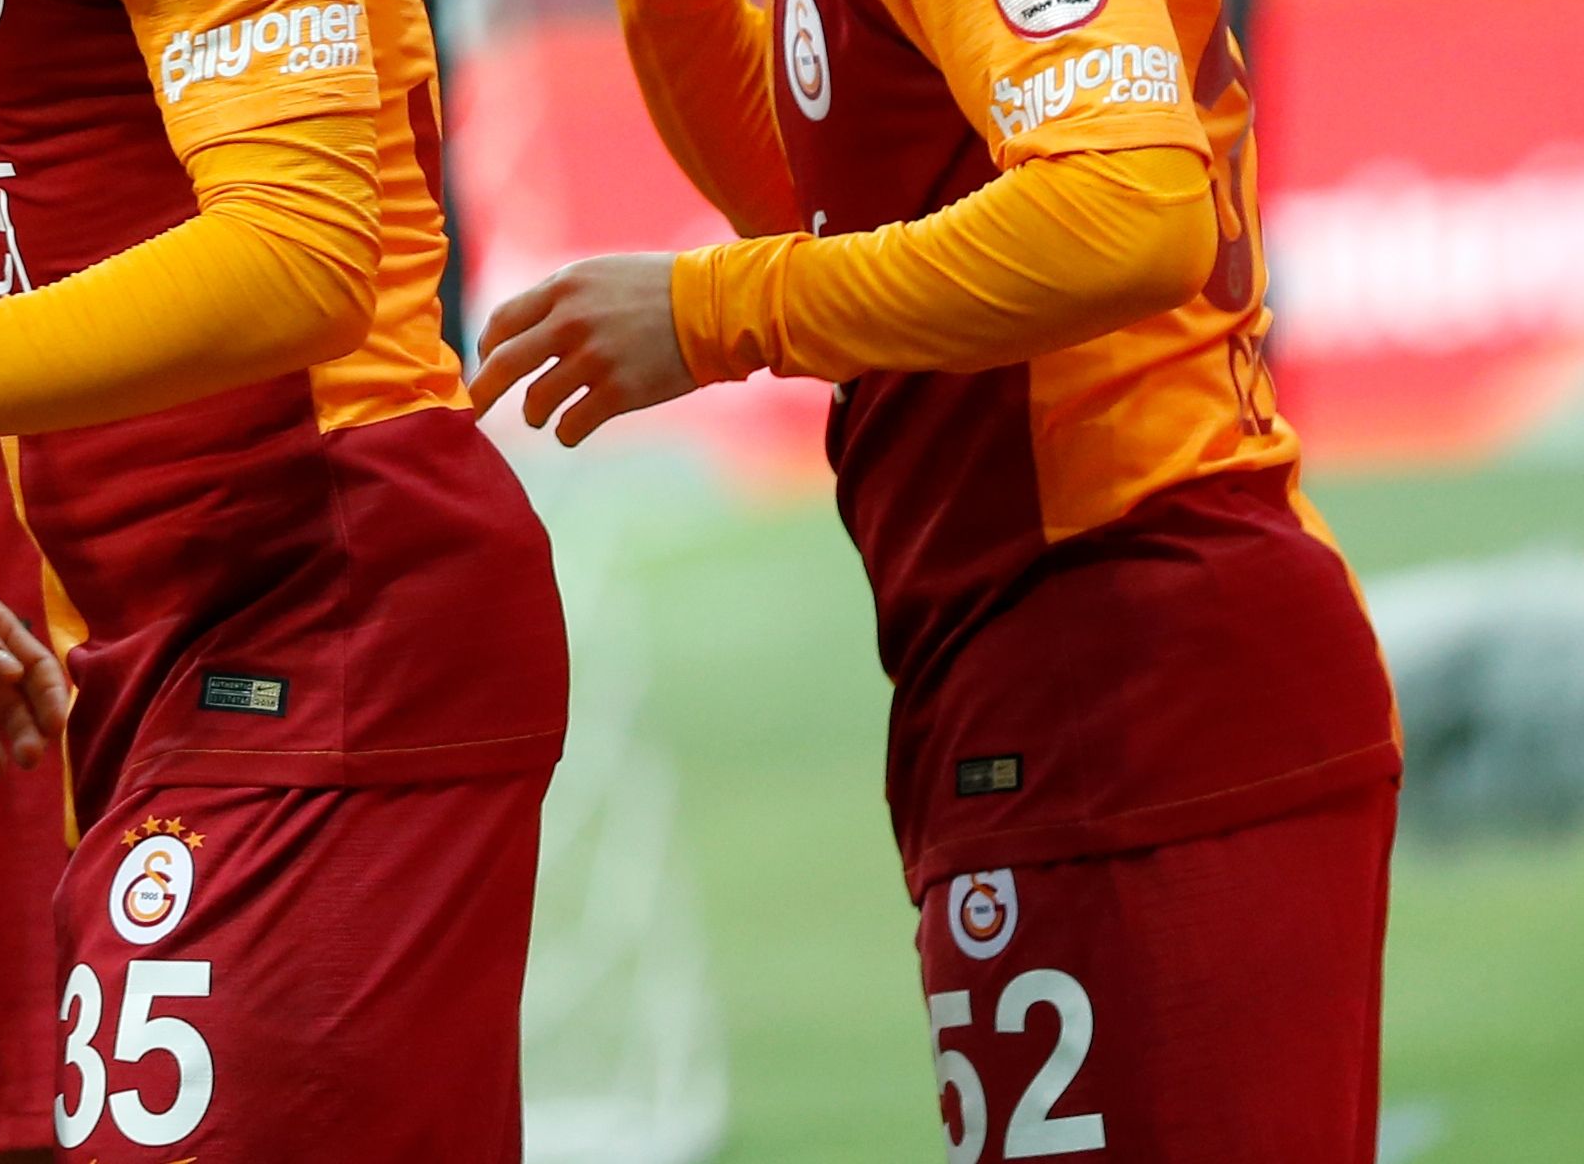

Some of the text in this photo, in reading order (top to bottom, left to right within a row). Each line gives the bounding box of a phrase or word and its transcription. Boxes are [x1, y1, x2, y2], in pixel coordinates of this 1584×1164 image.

[162, 3, 362, 104] Bilyoner
[280, 42, 358, 73] .com
[991, 43, 1178, 140] Bilyoner
[1102, 78, 1179, 104] .com
[54, 960, 214, 1148] 35
[930, 968, 1106, 1164] 52
